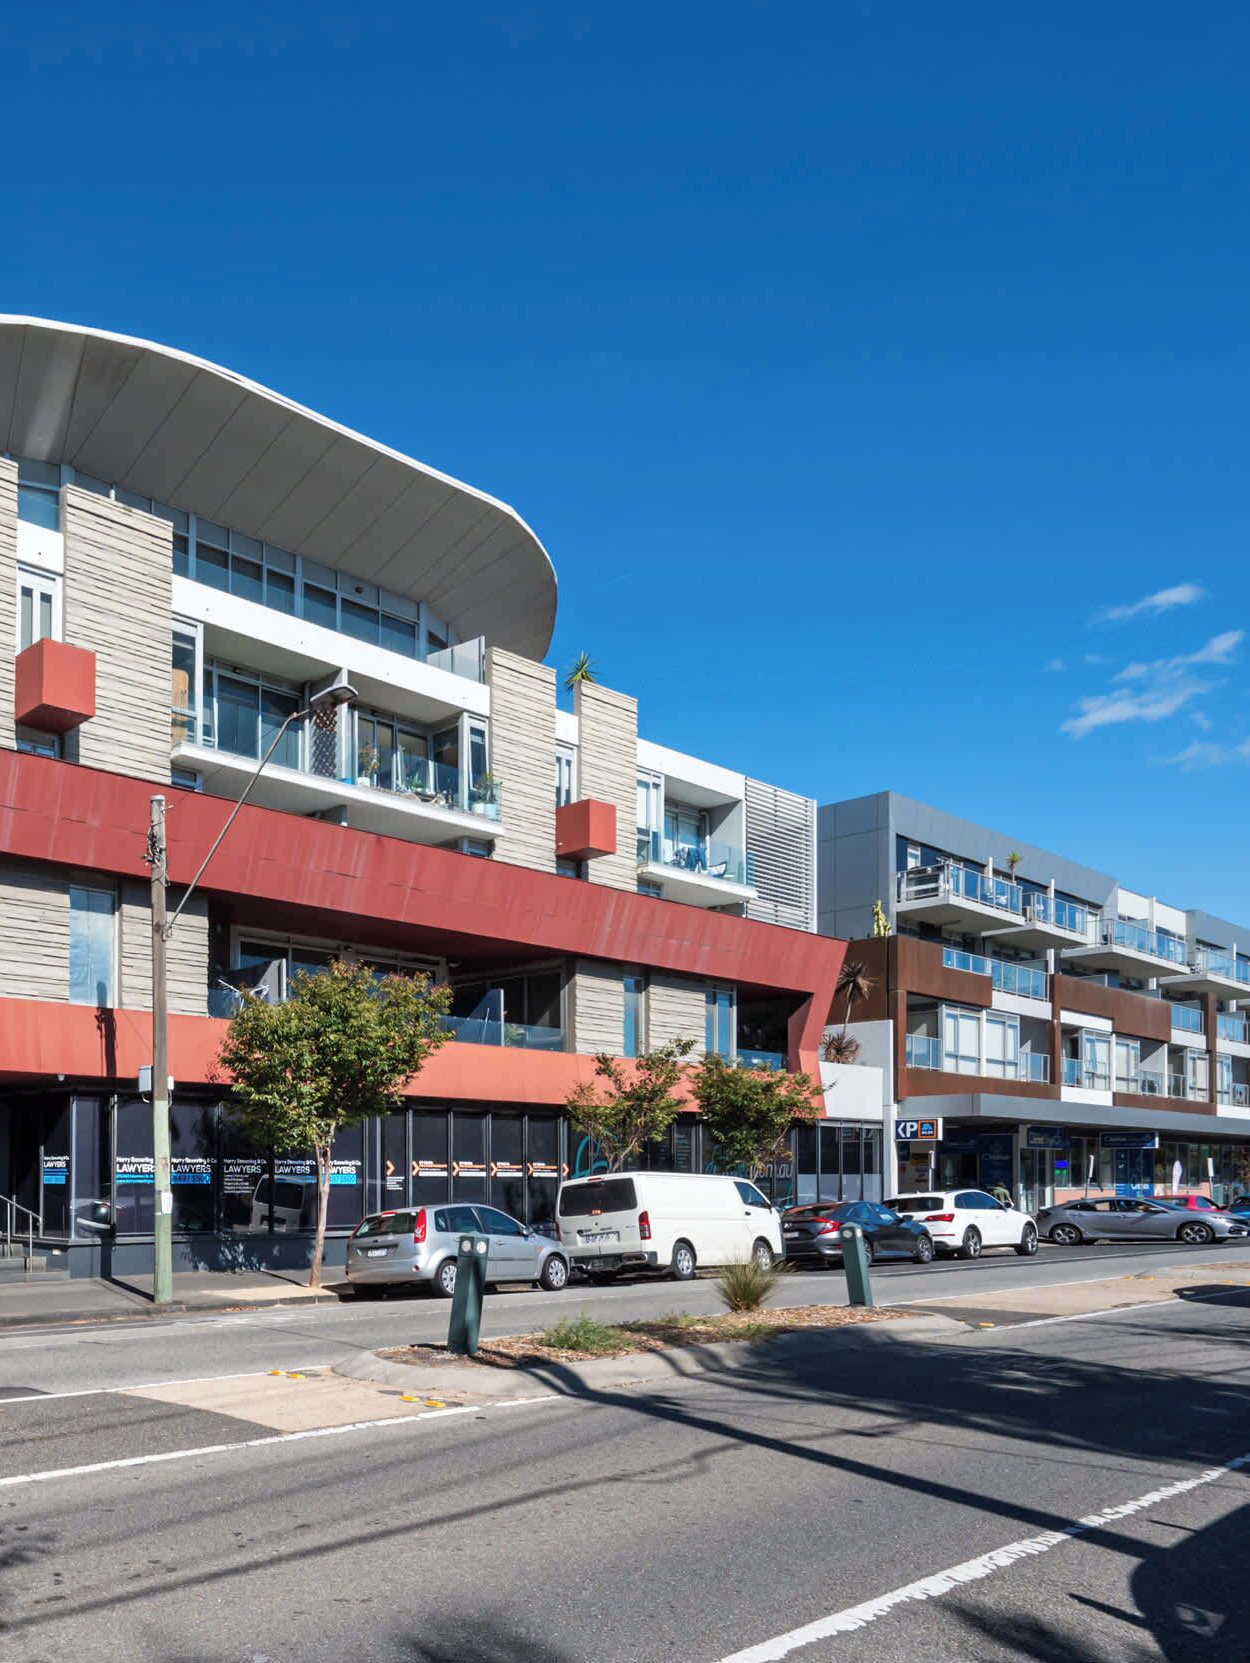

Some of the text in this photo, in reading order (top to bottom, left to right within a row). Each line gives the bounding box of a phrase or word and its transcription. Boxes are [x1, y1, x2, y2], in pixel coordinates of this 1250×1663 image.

[116, 1164, 154, 1172] LAWYER
[171, 1164, 211, 1173] LAWYERS
[223, 1165, 261, 1173] LAWYERS
[274, 1166, 310, 1174] LAWYERS
[322, 1166, 356, 1174] LWYERS
